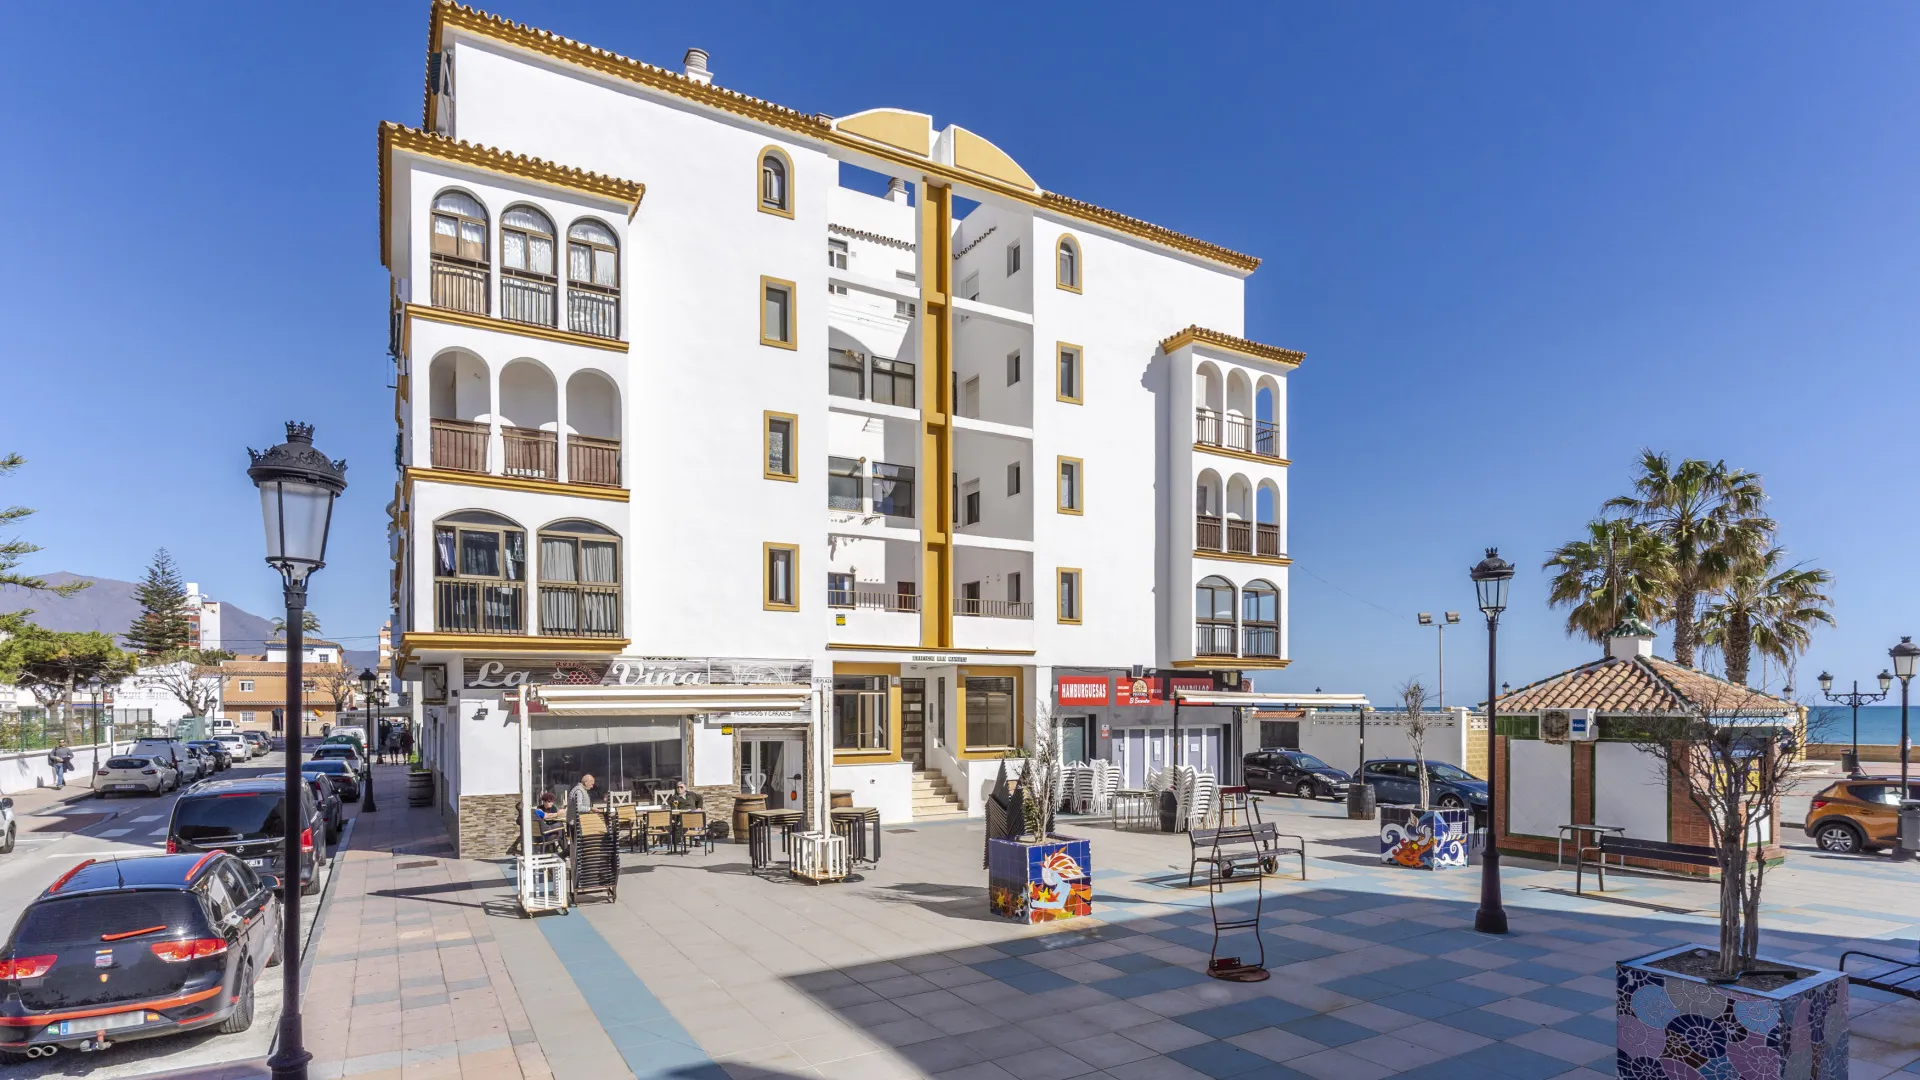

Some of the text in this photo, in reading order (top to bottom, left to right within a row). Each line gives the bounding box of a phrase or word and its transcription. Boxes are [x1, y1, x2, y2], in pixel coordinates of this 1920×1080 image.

[469, 661, 705, 687] La Viña
[1061, 684, 1106, 698] HAMBURGUESAS
